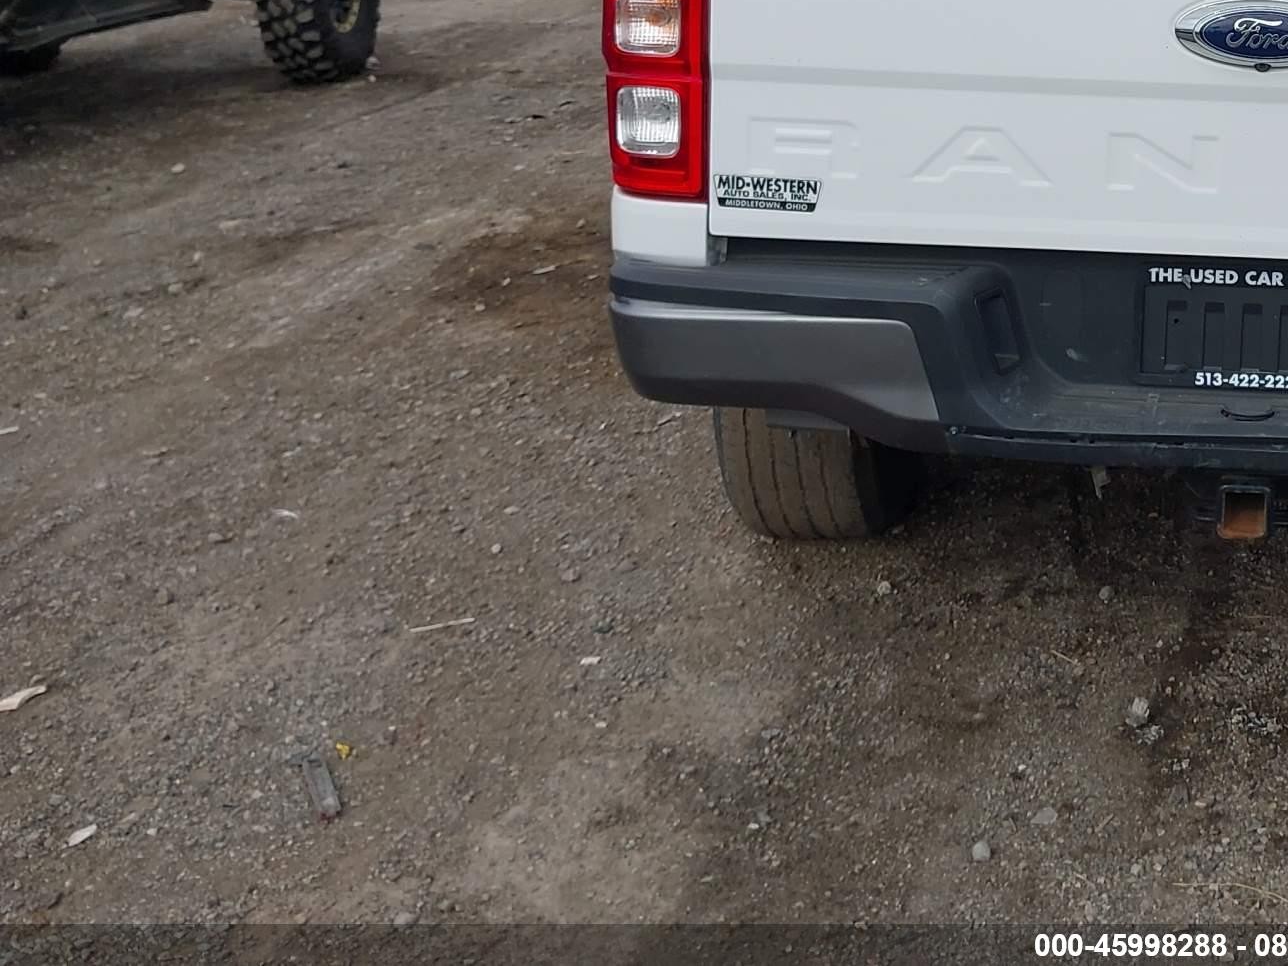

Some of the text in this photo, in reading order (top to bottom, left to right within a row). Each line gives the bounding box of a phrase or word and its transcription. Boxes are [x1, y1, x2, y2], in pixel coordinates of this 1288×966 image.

[718, 175, 817, 195] MID-WESTERN
[724, 189, 812, 202] AUTO SALES, INC.
[786, 203, 808, 211] OHIO
[1148, 267, 1183, 283] THE
[1190, 269, 1238, 286] USED
[1245, 271, 1284, 287] CAR
